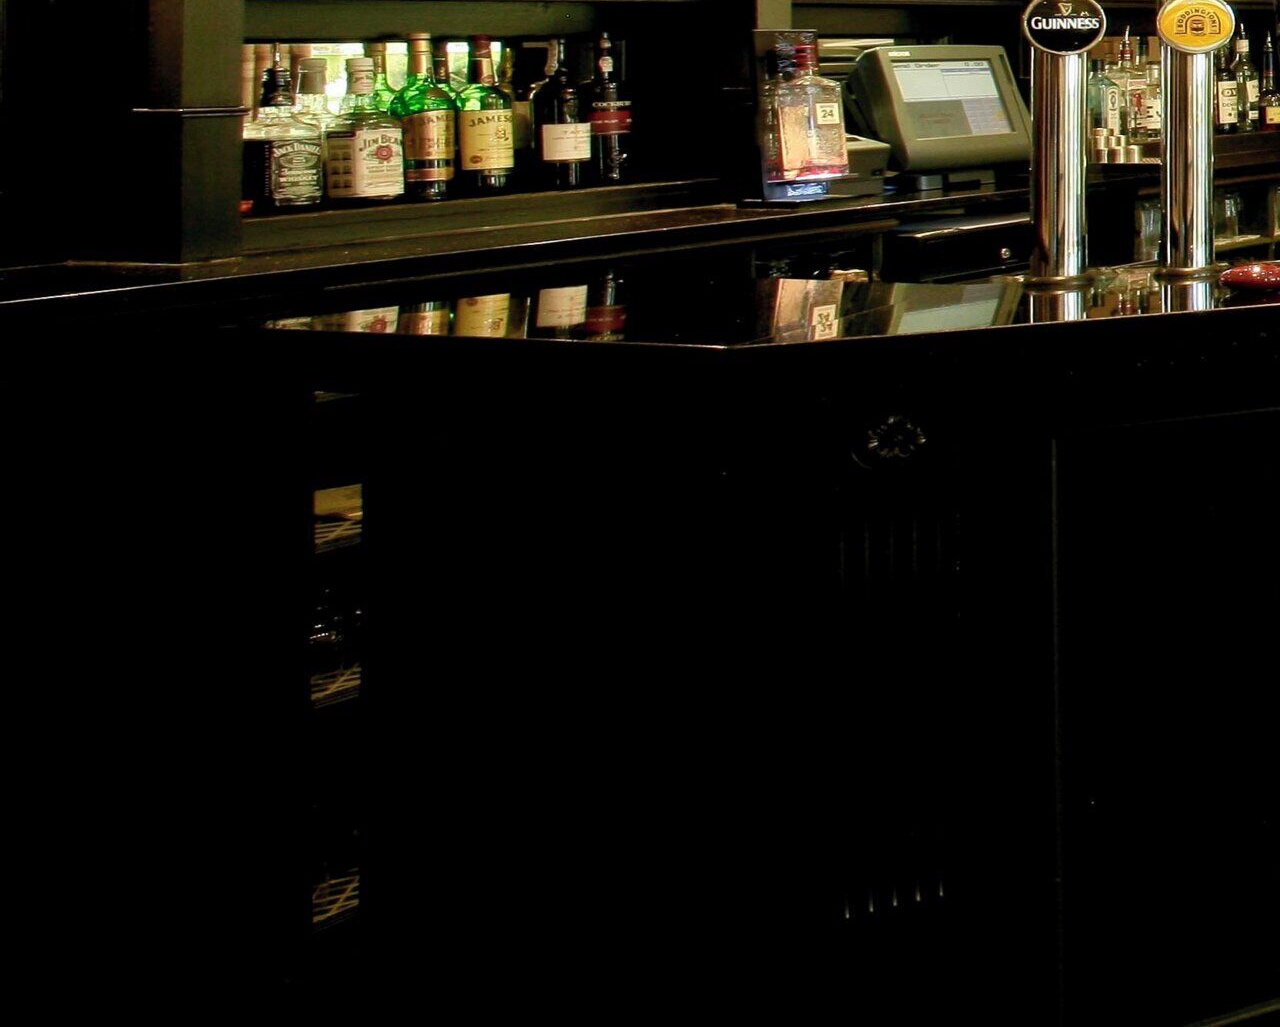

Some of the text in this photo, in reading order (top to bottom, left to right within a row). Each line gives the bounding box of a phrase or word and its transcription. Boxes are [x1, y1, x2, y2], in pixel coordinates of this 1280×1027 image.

[1031, 16, 1100, 30] GUINNESS
[1177, 8, 1218, 29] BODDINGTONS
[821, 108, 834, 119] 24
